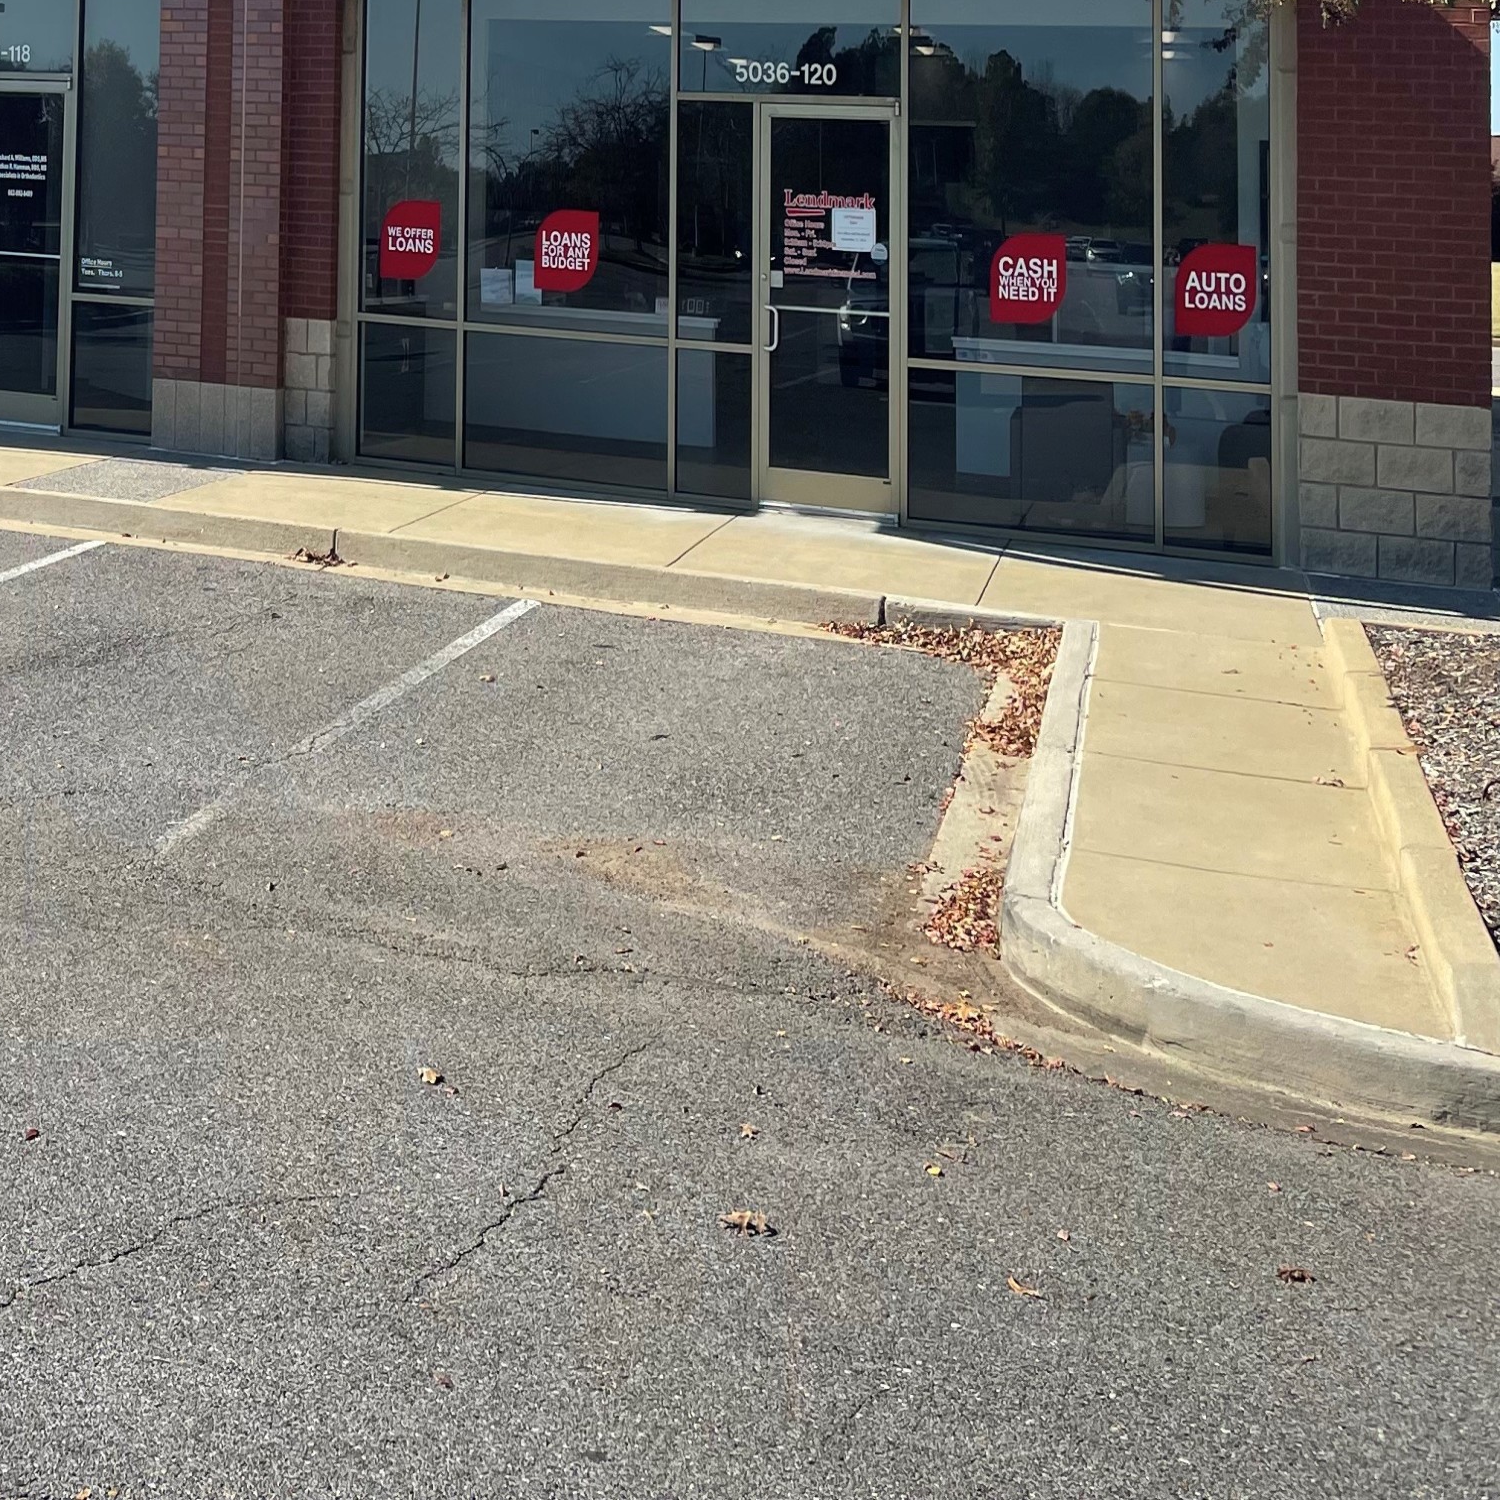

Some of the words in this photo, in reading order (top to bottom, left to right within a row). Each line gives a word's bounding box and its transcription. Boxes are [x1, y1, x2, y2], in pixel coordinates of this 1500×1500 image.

[735, 61, 837, 86] 5036-120
[784, 189, 876, 210] Lendmark
[387, 226, 402, 236] WE
[404, 227, 434, 239] OFFER
[542, 230, 591, 247] LOANS
[388, 237, 434, 254] LOANS
[542, 244, 564, 257] FOR
[567, 246, 591, 258] ANY
[541, 255, 591, 271] BUDGET
[998, 256, 1058, 279] CASH
[999, 275, 1031, 288] WHEN
[1034, 277, 1058, 289] YOU
[1185, 271, 1247, 293] AUTO
[998, 285, 1039, 301] NEED
[1043, 288, 1058, 302] IT
[1184, 292, 1247, 312] LOANS
